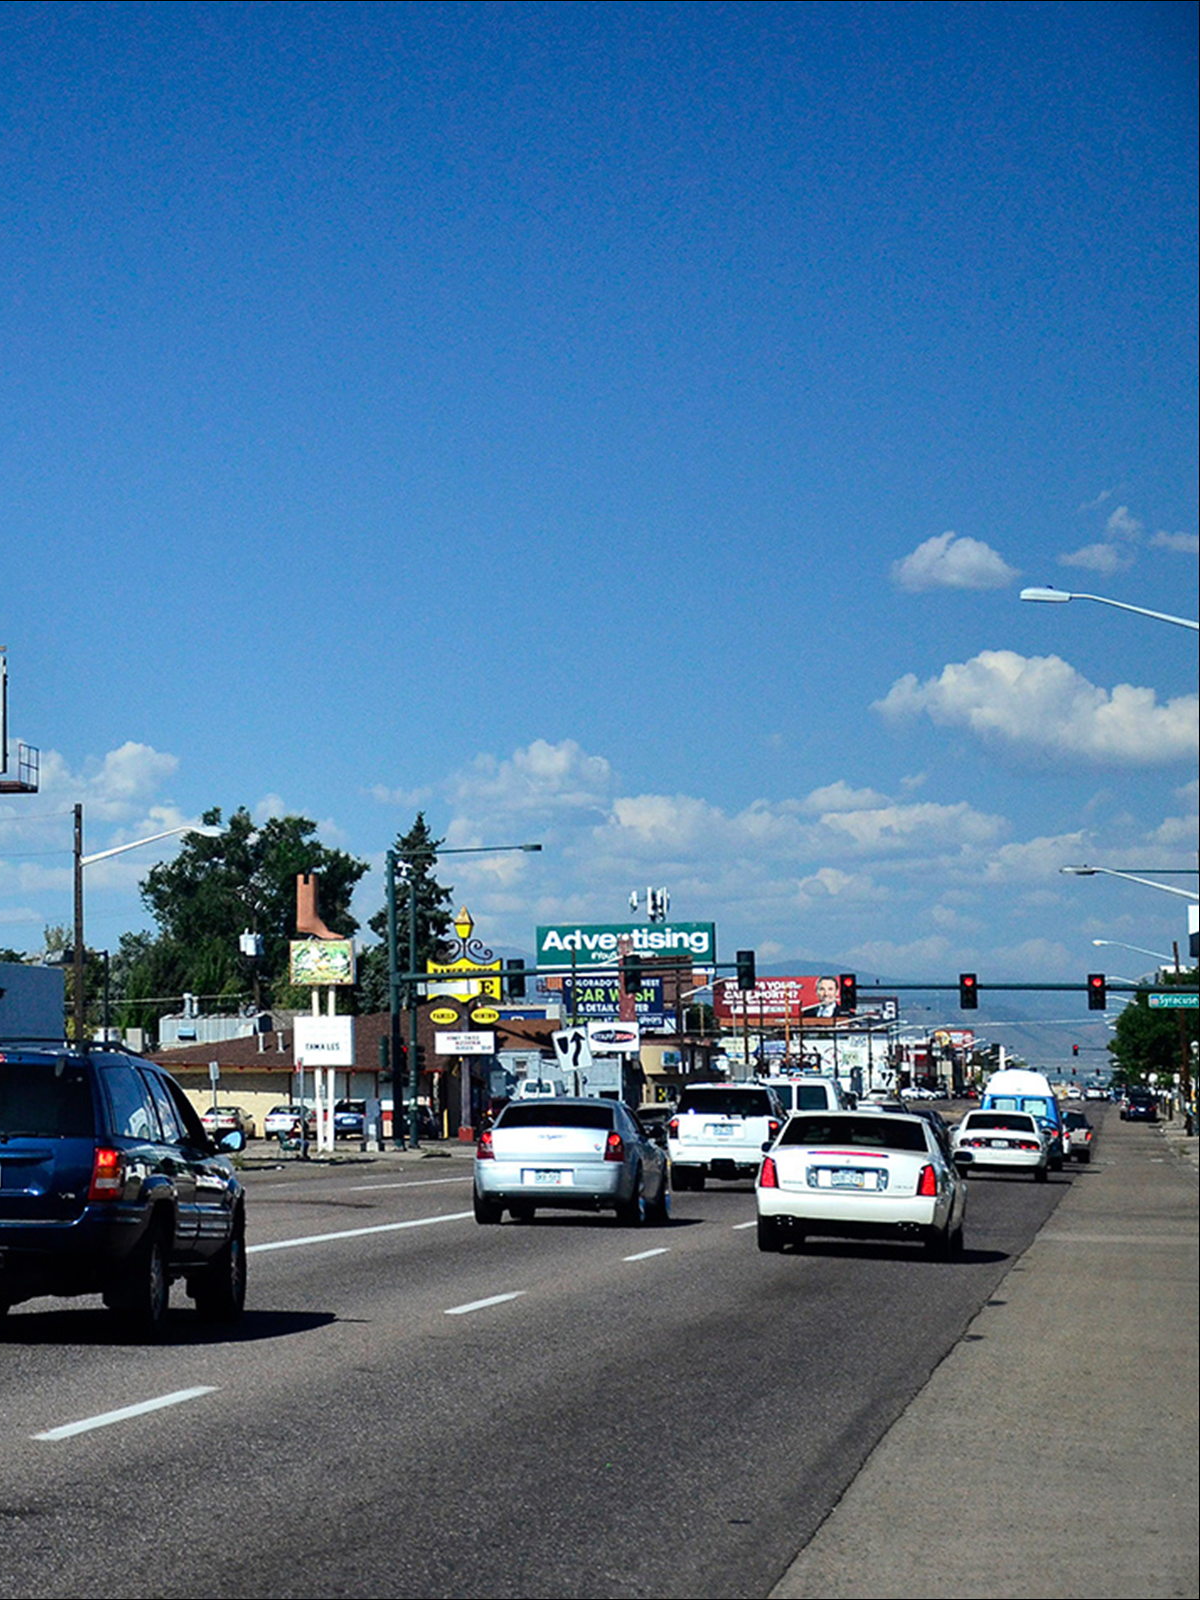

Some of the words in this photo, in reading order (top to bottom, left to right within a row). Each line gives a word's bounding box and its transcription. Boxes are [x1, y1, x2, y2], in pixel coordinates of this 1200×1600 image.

[542, 928, 709, 953] Advetising
[565, 979, 619, 988] CLORADO'S
[609, 988, 655, 1002] WSH
[615, 1003, 649, 1012] CTER
